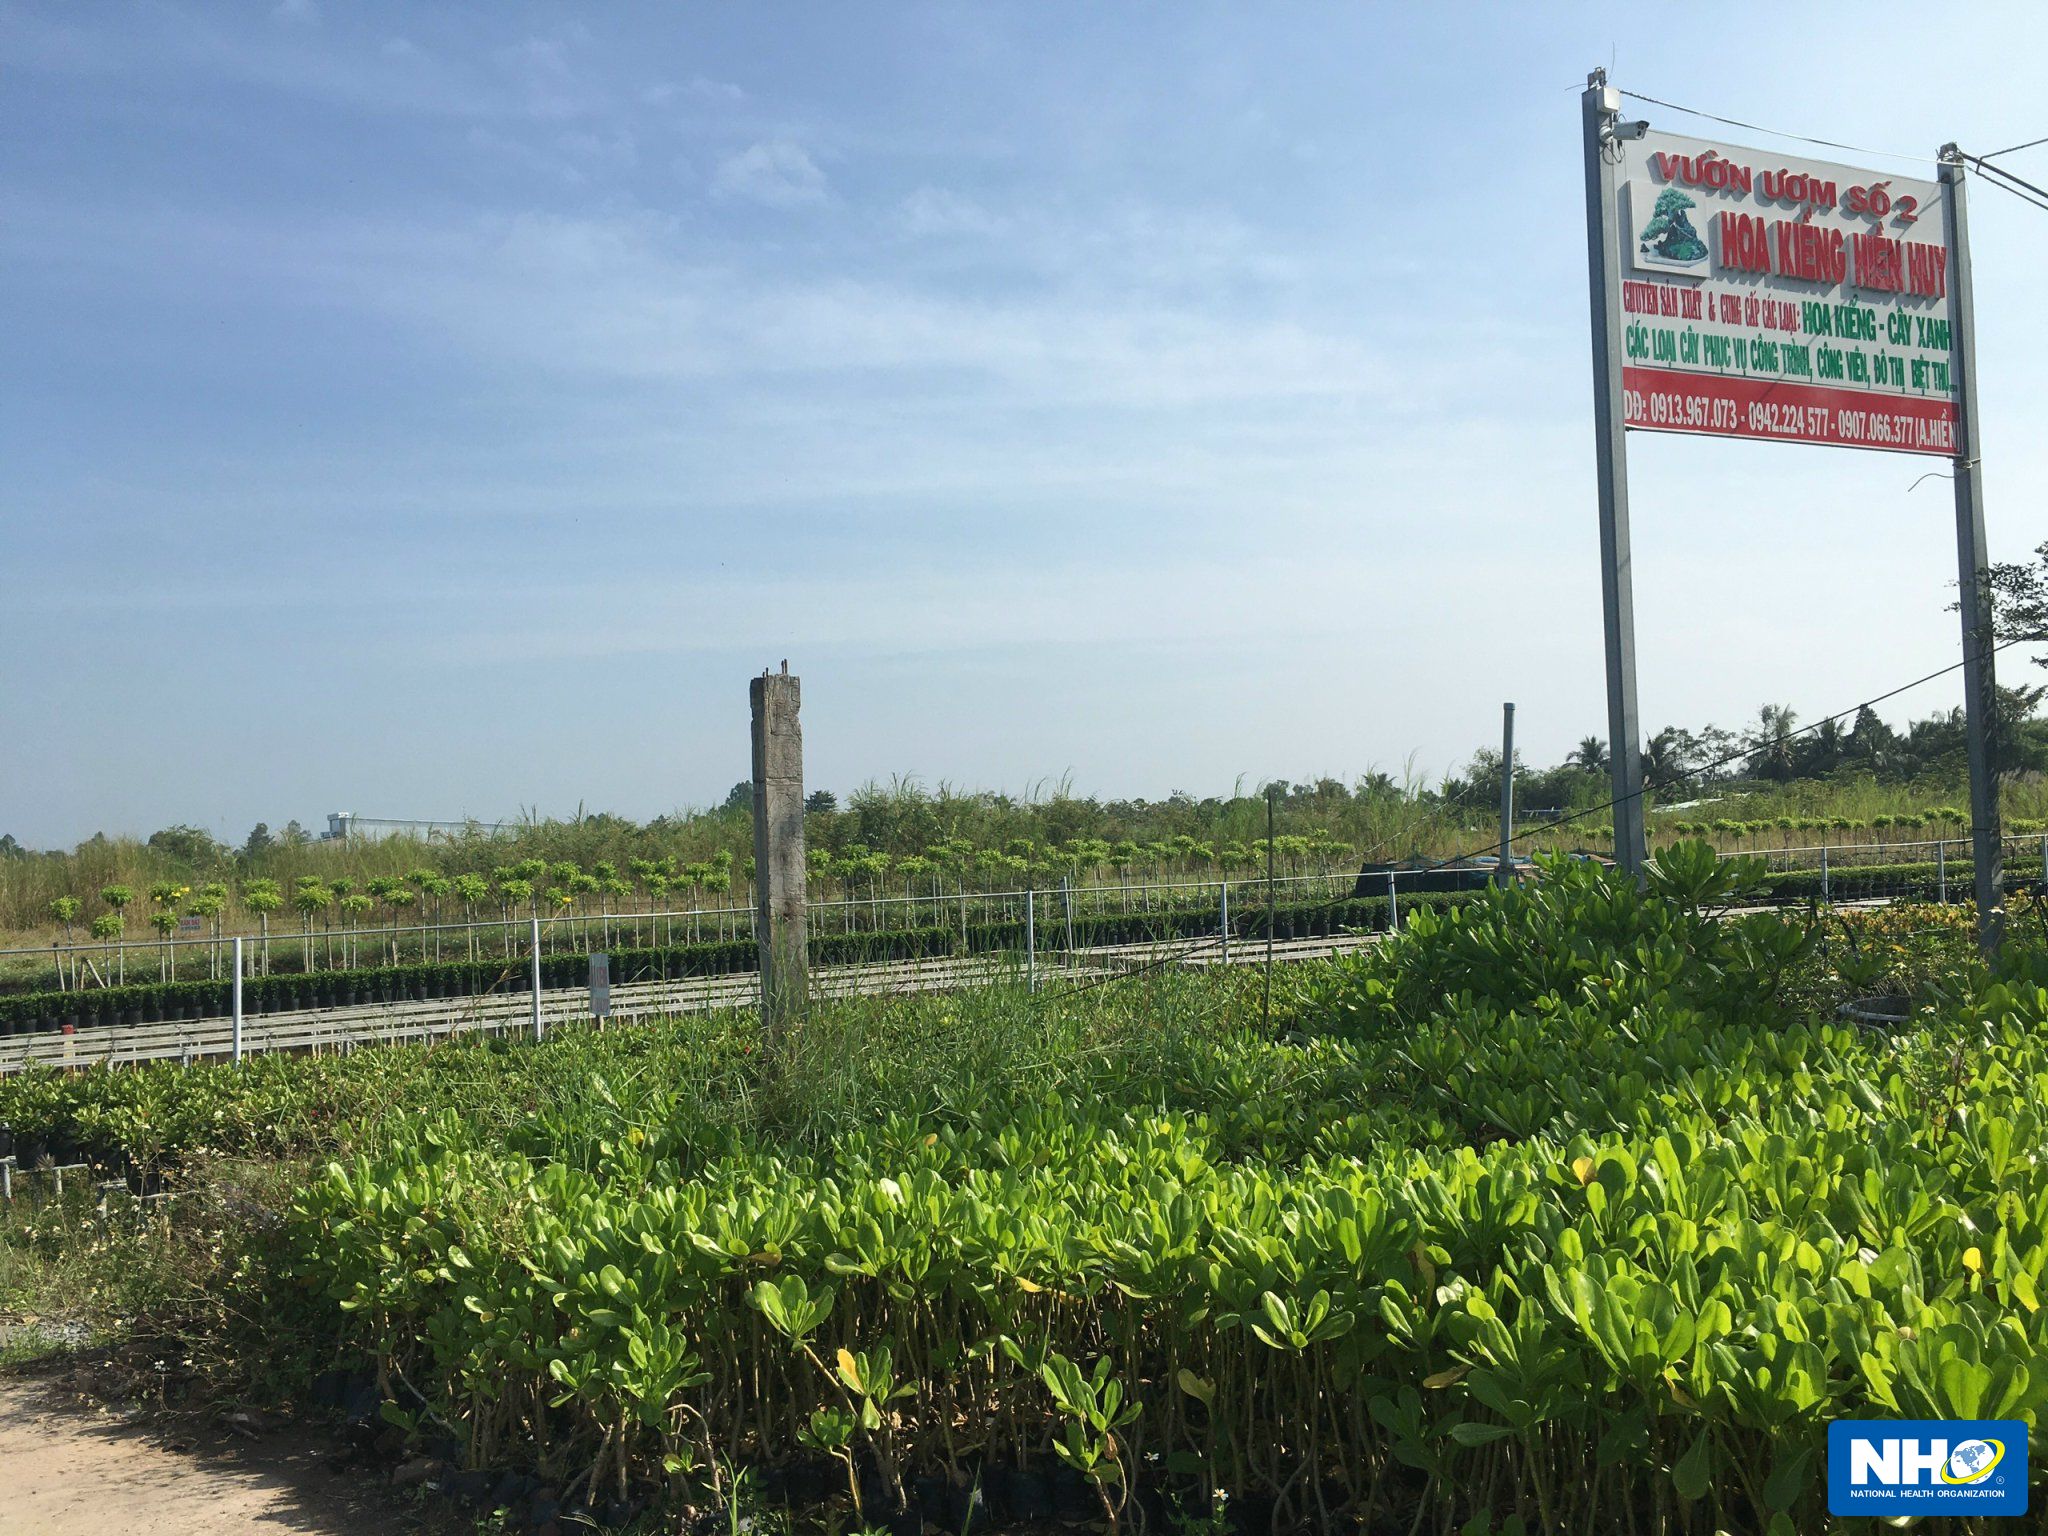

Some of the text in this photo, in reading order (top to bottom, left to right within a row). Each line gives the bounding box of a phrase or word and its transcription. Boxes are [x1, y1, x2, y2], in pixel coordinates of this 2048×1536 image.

[1764, 168, 1836, 207] ƯƠM
[1850, 181, 1892, 216] SỐ
[1900, 195, 1918, 221] 2
[1720, 210, 1771, 273] HOA
[1907, 242, 1947, 299] HUY
[1623, 277, 1658, 315] CHUYÊN
[1660, 278, 1678, 317] SẢN
[1680, 282, 1702, 320] XUẤT
[1708, 291, 1716, 322] &
[1720, 293, 1742, 326] CUNG
[1745, 290, 1760, 327] CẤP
[1762, 293, 1777, 330] CÁC
[1778, 301, 1801, 336] LOẠI:
[1802, 301, 1832, 337] HOA
[1887, 306, 1912, 346] CÂY
[1916, 316, 1953, 351] XANH
[1626, 319, 1649, 359] CÁC
[1652, 328, 1677, 368] LOẠI
[1680, 325, 1699, 364] CÂY
[1703, 334, 1730, 374] PHỤC
[1733, 337, 1747, 376] VỤ
[1751, 333, 1779, 373] CÔNG
[1817, 341, 1844, 380] CÔNG
[1873, 348, 1888, 385] ĐÔ
[1889, 356, 1905, 394] THỊ
[1623, 389, 1647, 422] DĐ:
[1651, 392, 1738, 429] 0913.967.073
